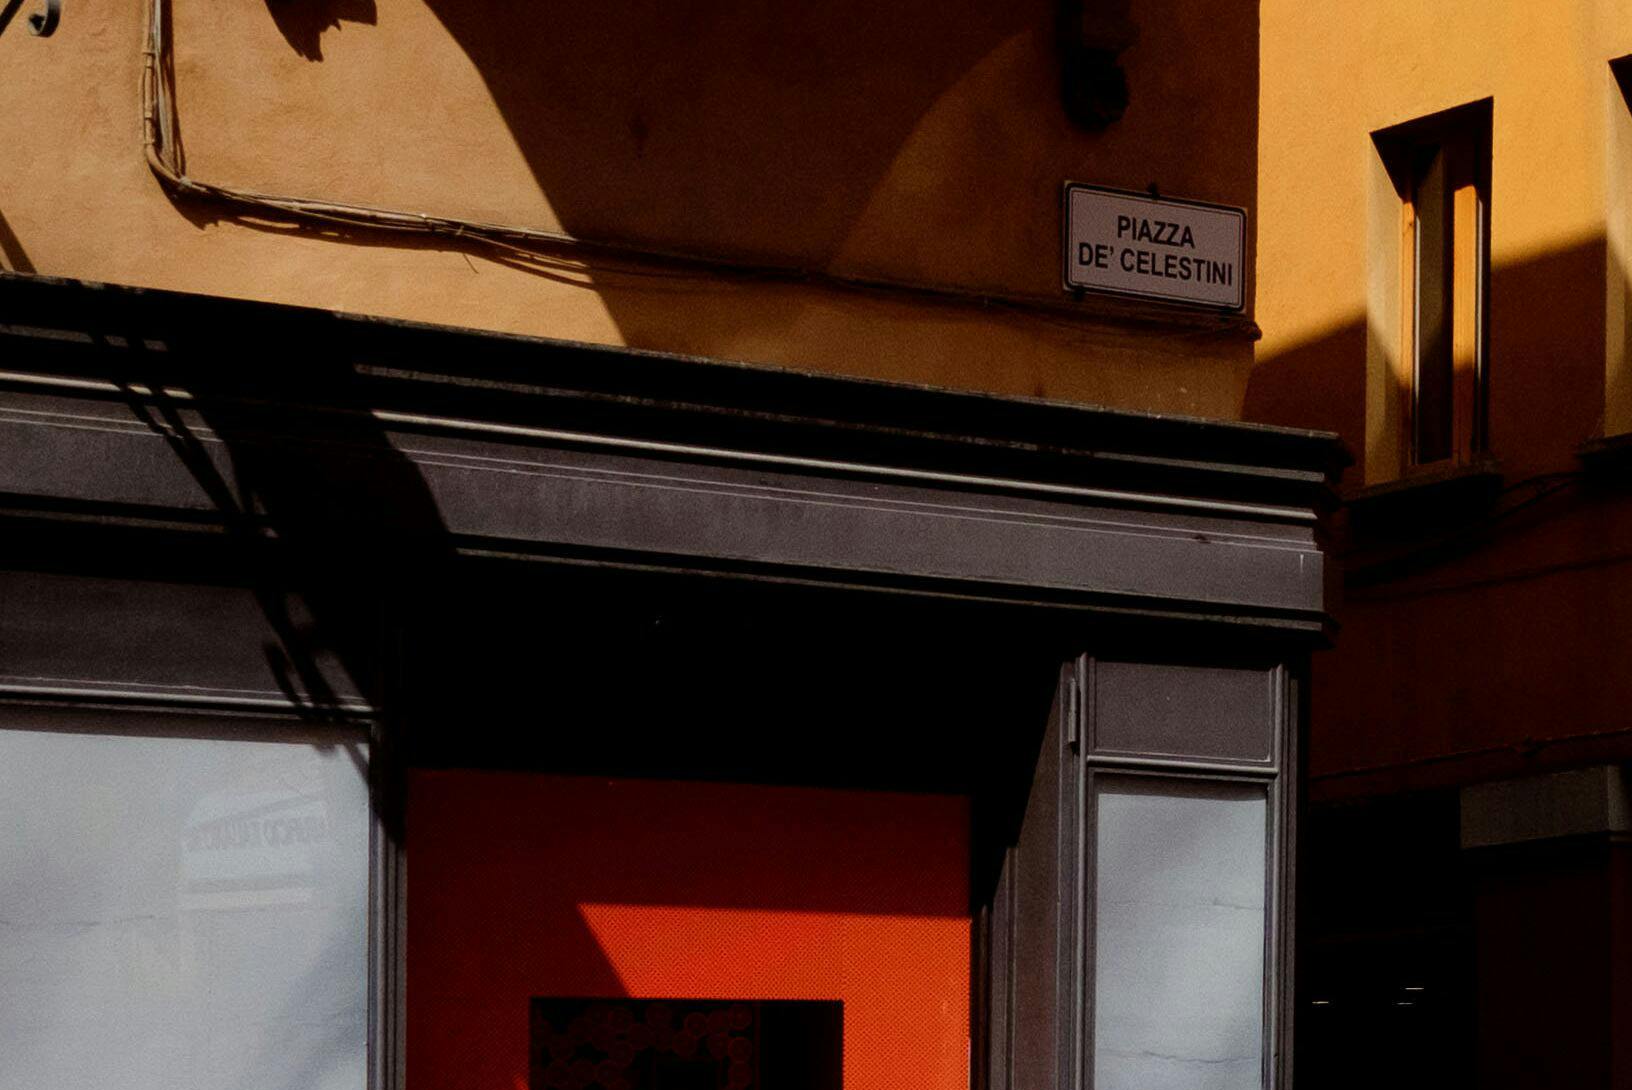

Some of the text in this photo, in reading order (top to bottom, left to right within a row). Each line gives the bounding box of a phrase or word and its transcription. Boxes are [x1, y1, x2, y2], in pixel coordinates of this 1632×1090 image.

[1117, 214, 1196, 249] PIAZZA
[1078, 242, 1233, 286] DE' CELESTINI
